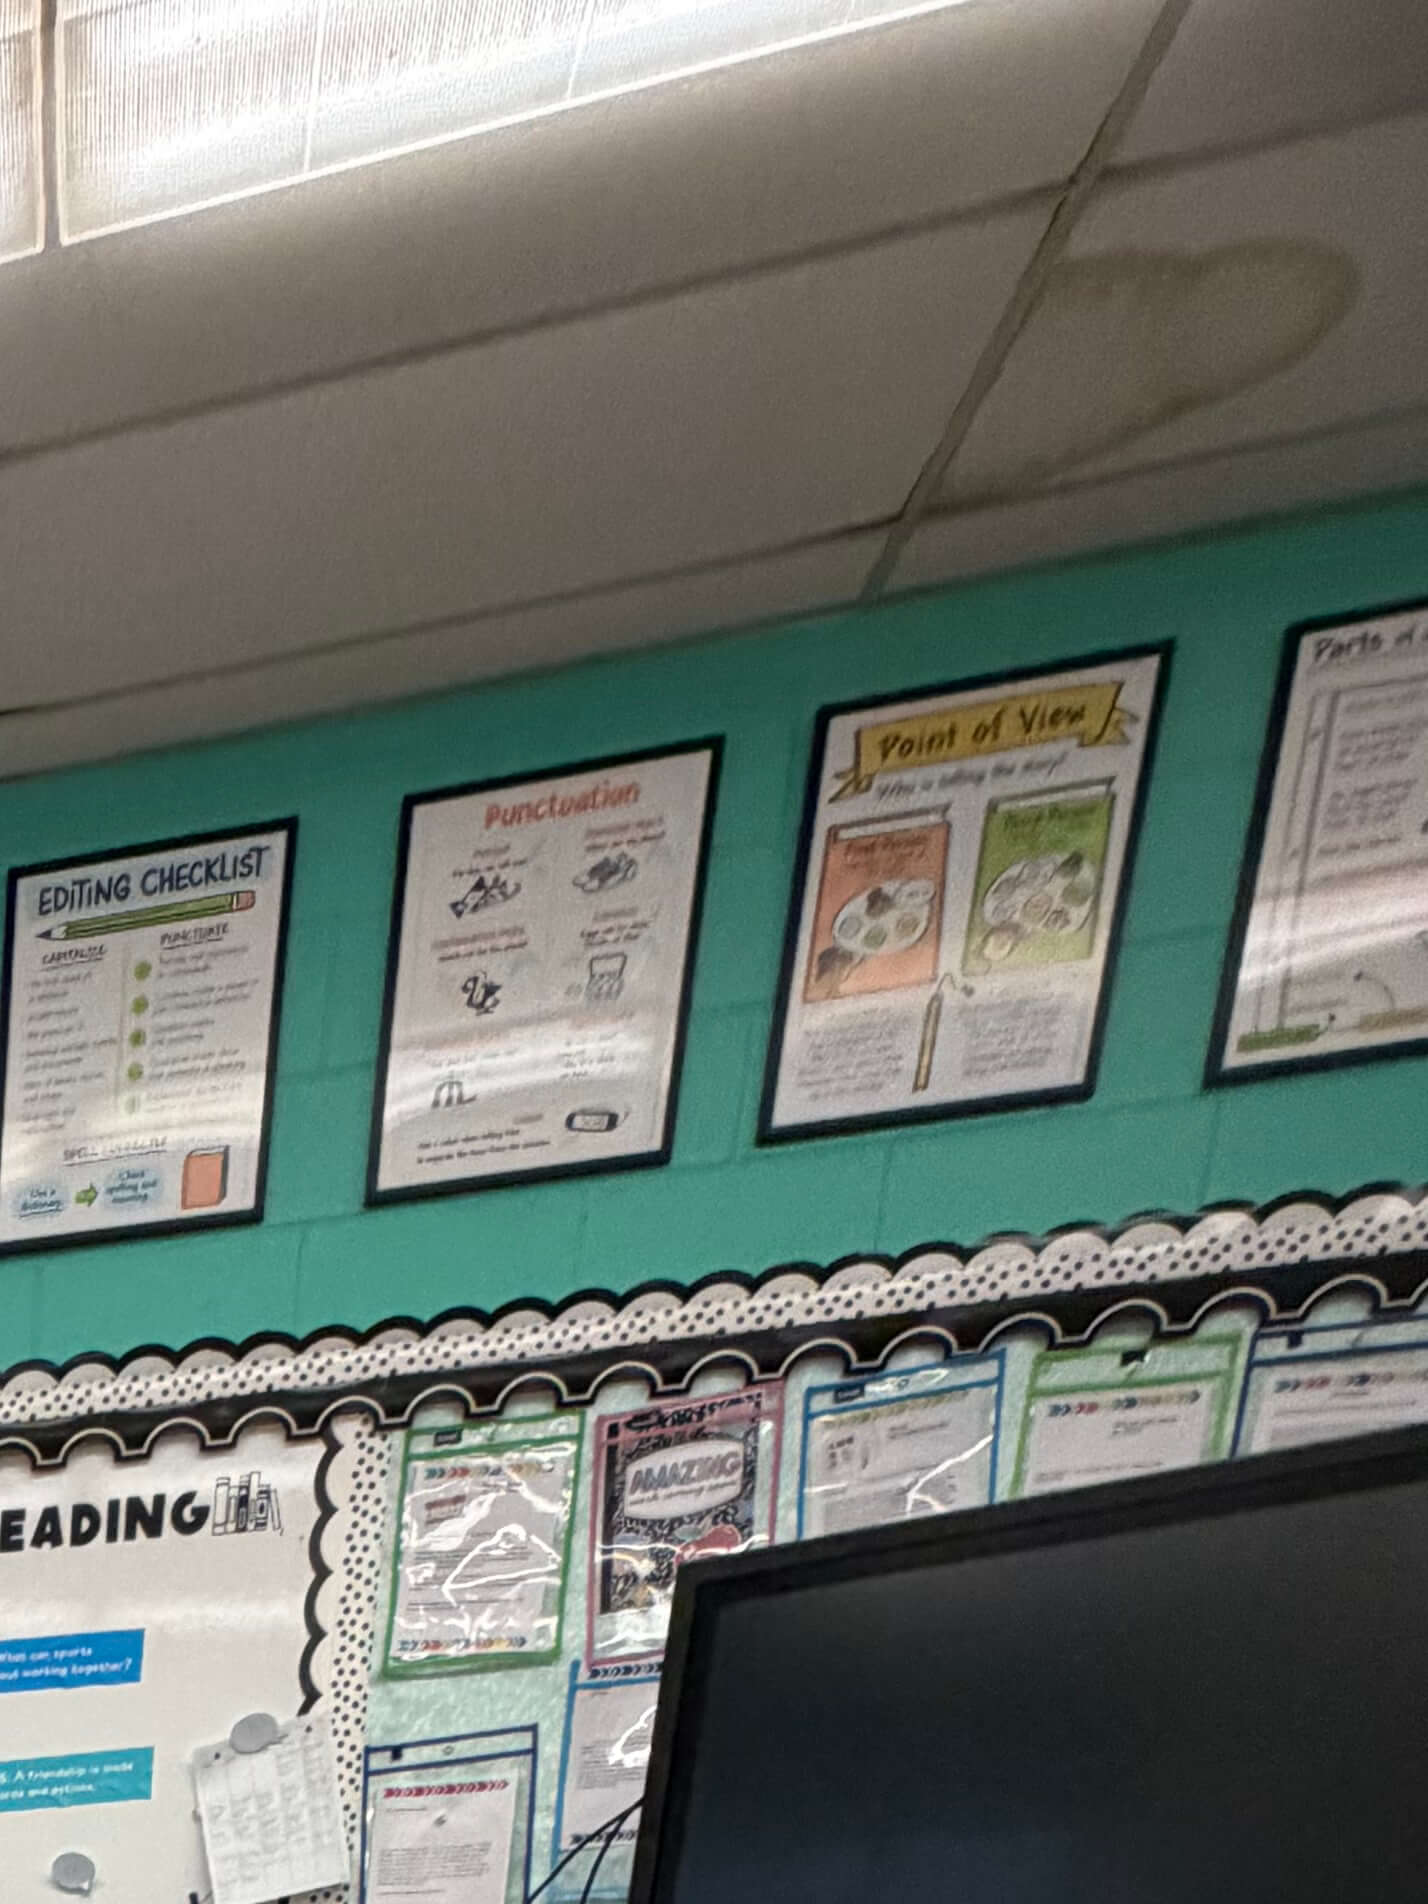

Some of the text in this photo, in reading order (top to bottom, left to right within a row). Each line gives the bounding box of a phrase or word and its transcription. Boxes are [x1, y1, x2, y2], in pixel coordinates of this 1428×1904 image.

[1314, 634, 1383, 664] Parts
[879, 703, 1086, 764] Point of View
[484, 779, 642, 831] Punctuation
[139, 844, 272, 896] CHECKLIST
[629, 1450, 743, 1496] AMAZING
[21, 1665, 68, 1680] working
[70, 1656, 133, 1676] together?
[29, 1649, 50, 1662] can
[53, 1646, 93, 1662] sports
[27, 1766, 88, 1782] friendship
[88, 1765, 100, 1776] is
[102, 1761, 135, 1774] made
[27, 1786, 49, 1799] and
